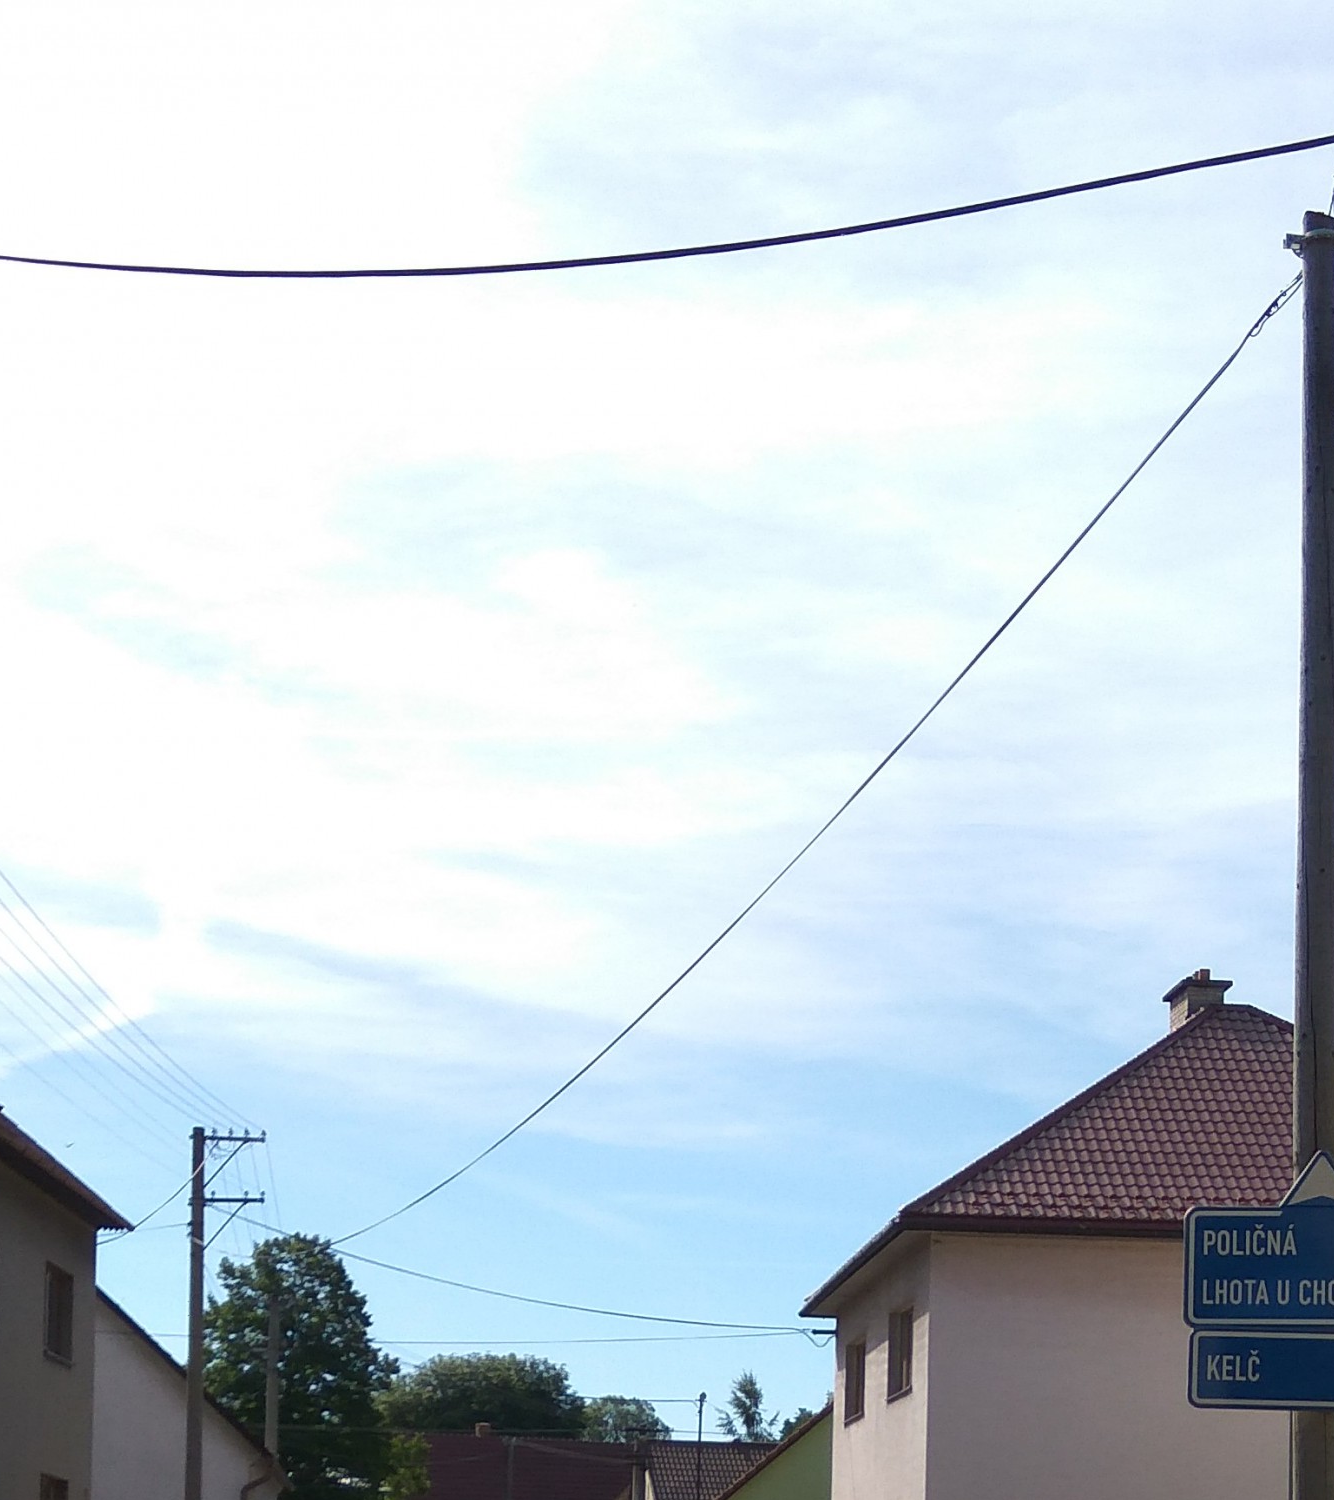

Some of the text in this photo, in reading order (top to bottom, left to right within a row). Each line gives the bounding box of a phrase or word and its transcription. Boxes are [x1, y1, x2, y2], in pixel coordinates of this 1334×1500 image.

[1202, 1224, 1298, 1256] POLIČNÁ
[1201, 1279, 1270, 1306] LHOTA
[1277, 1279, 1291, 1306] U
[1206, 1350, 1261, 1382] KELČ
